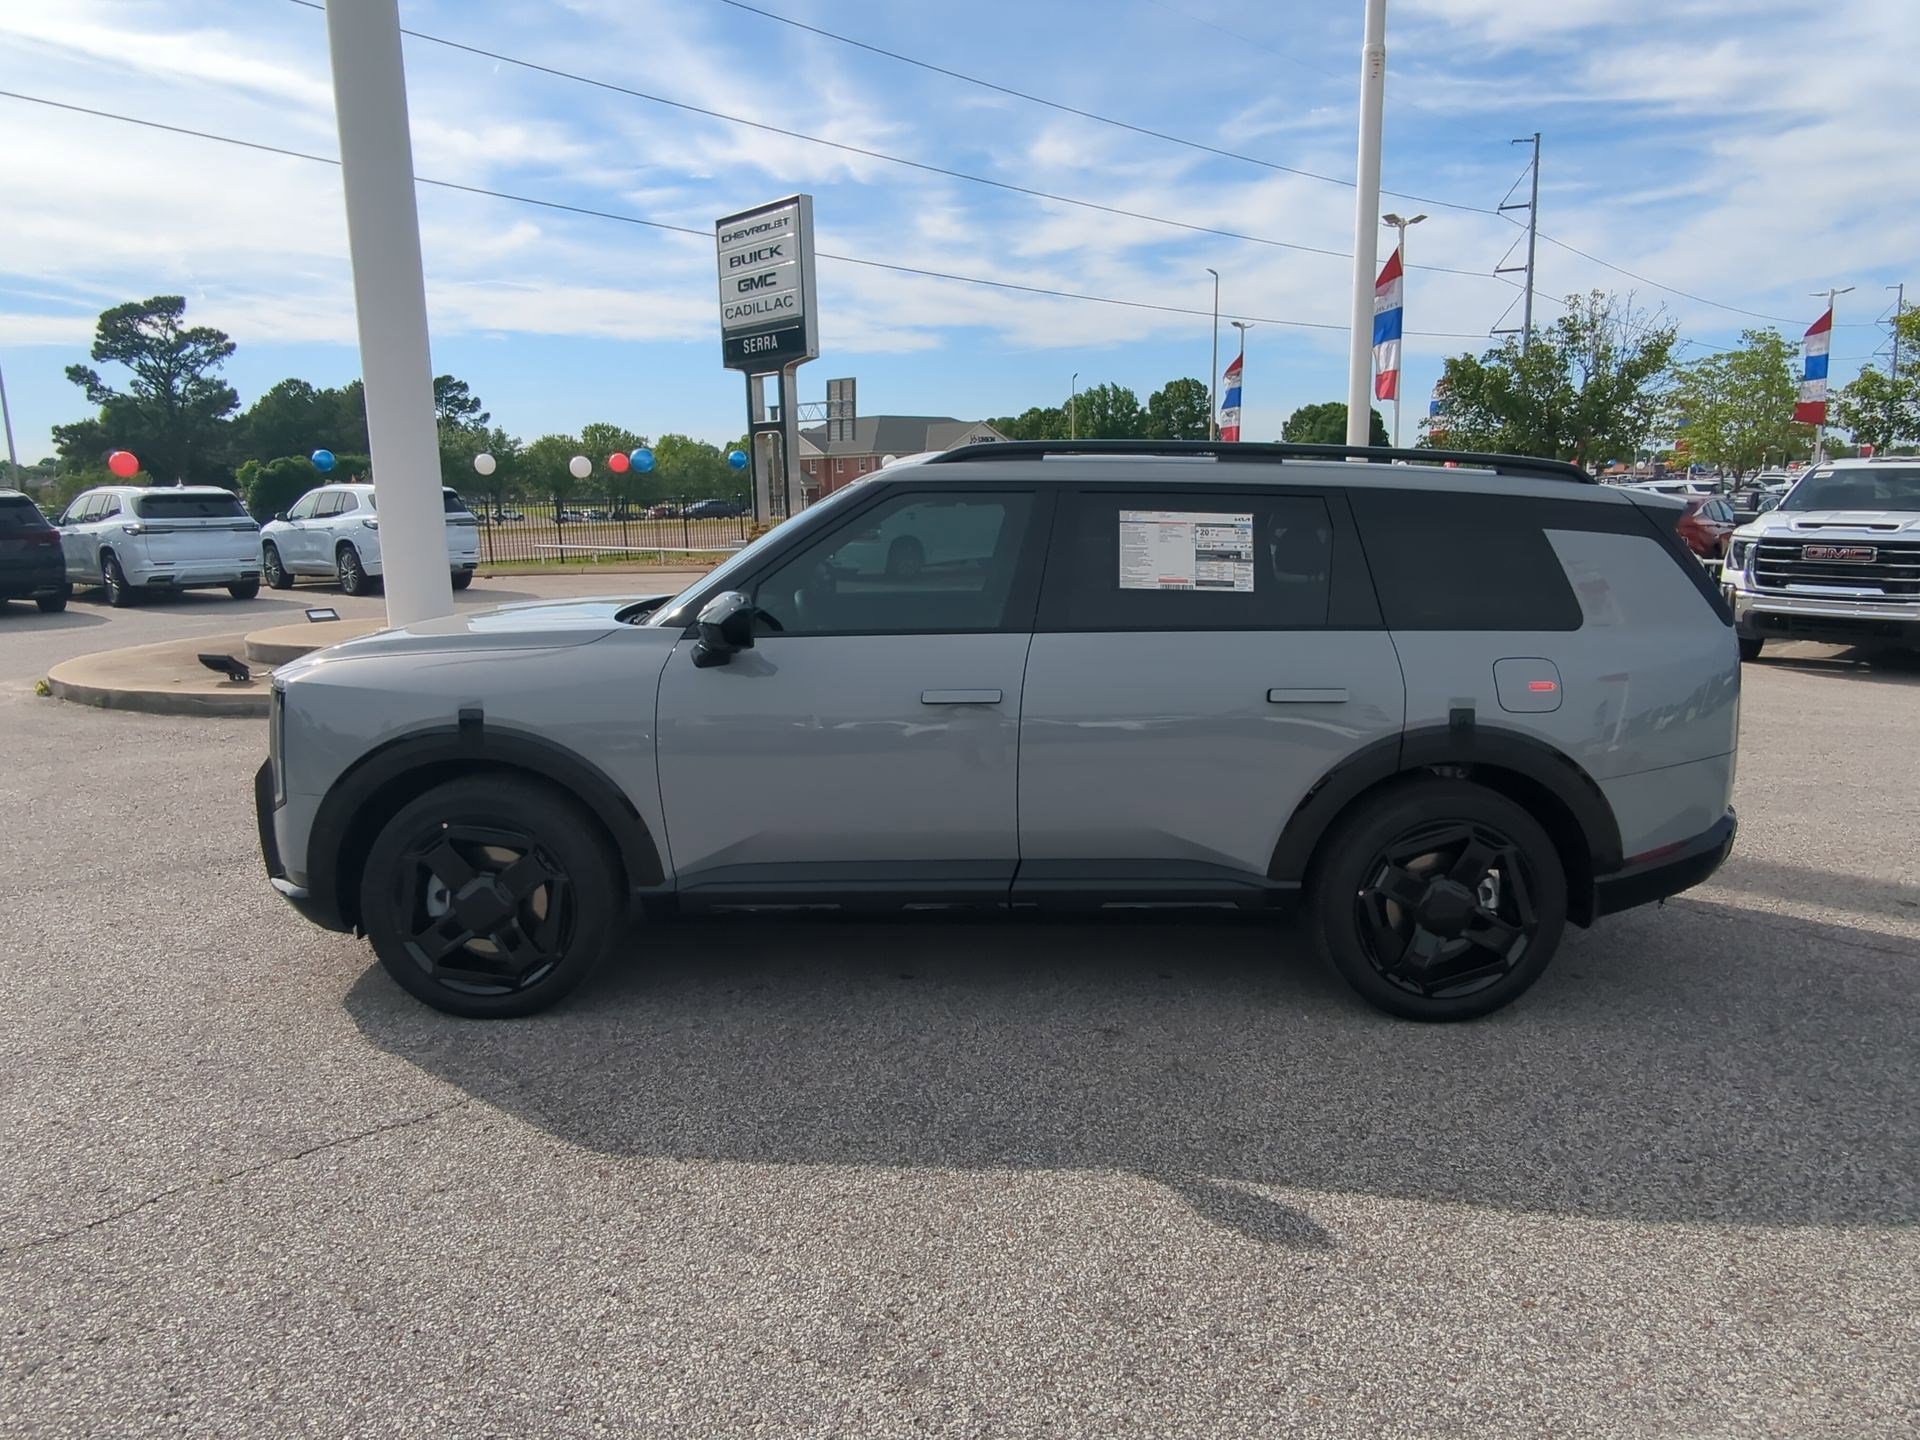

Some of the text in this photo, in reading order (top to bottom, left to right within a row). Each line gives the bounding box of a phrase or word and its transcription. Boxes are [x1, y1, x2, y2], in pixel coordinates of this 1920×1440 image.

[721, 217, 790, 243] CHEVROLET
[729, 245, 783, 268] BUICK
[737, 272, 777, 293] GMC
[725, 295, 794, 320] CADILLAC
[743, 334, 778, 354] SERRA
[1807, 546, 1873, 560] GMC
